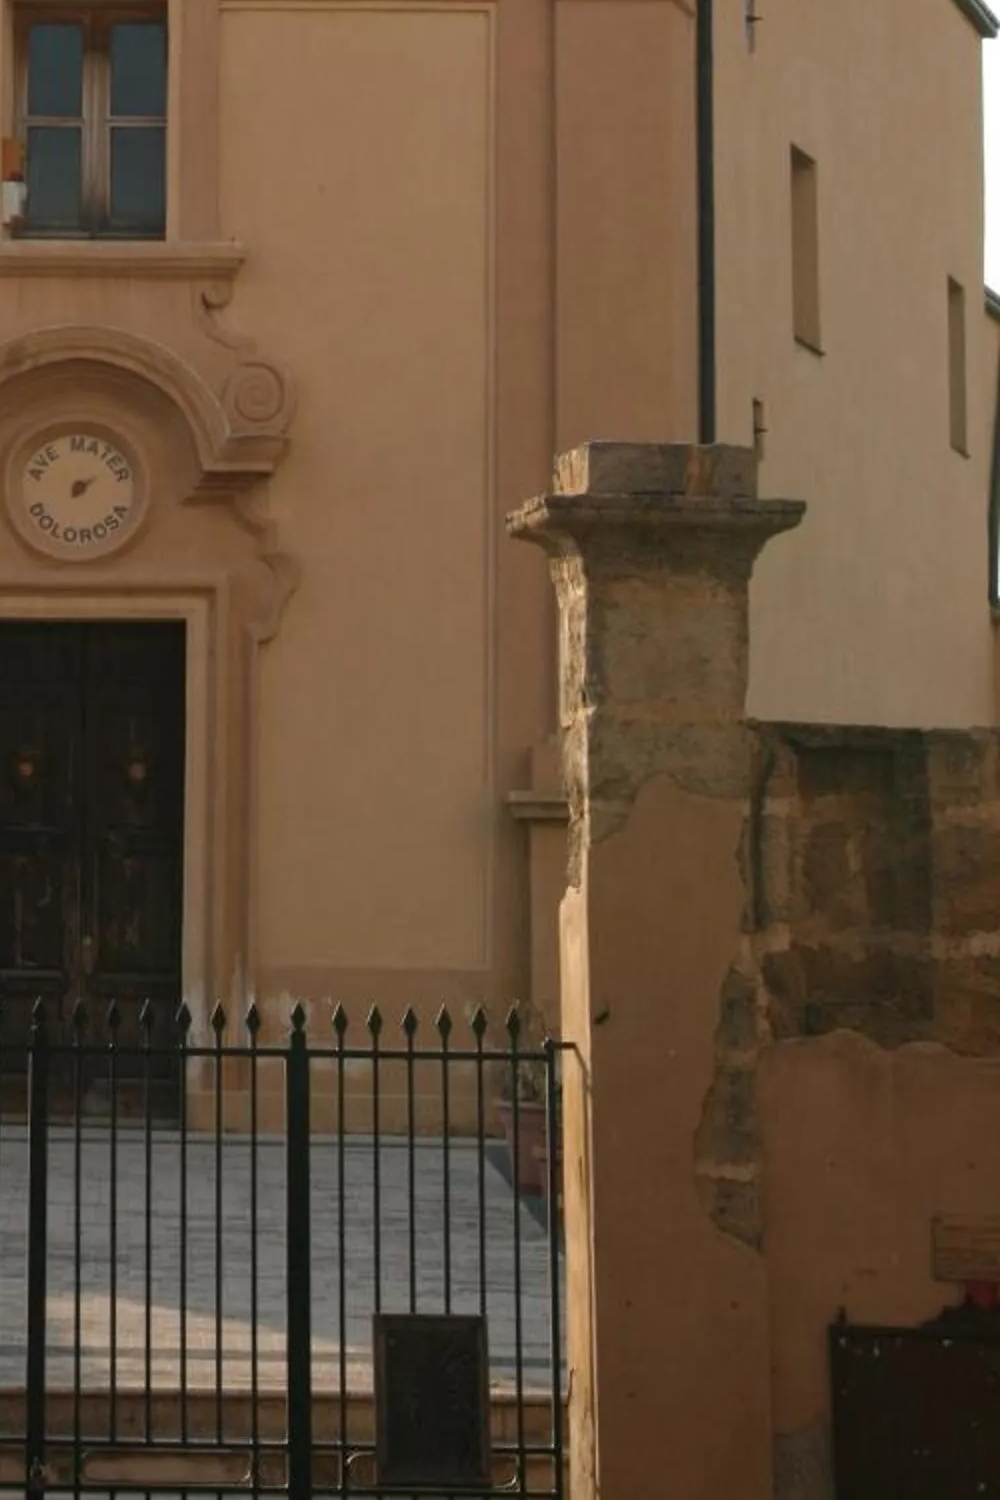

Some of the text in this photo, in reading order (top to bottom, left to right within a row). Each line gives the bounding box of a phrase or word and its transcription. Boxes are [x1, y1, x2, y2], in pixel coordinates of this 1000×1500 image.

[29, 436, 130, 483] AVE MATER
[29, 501, 129, 543] DOLOROSA
